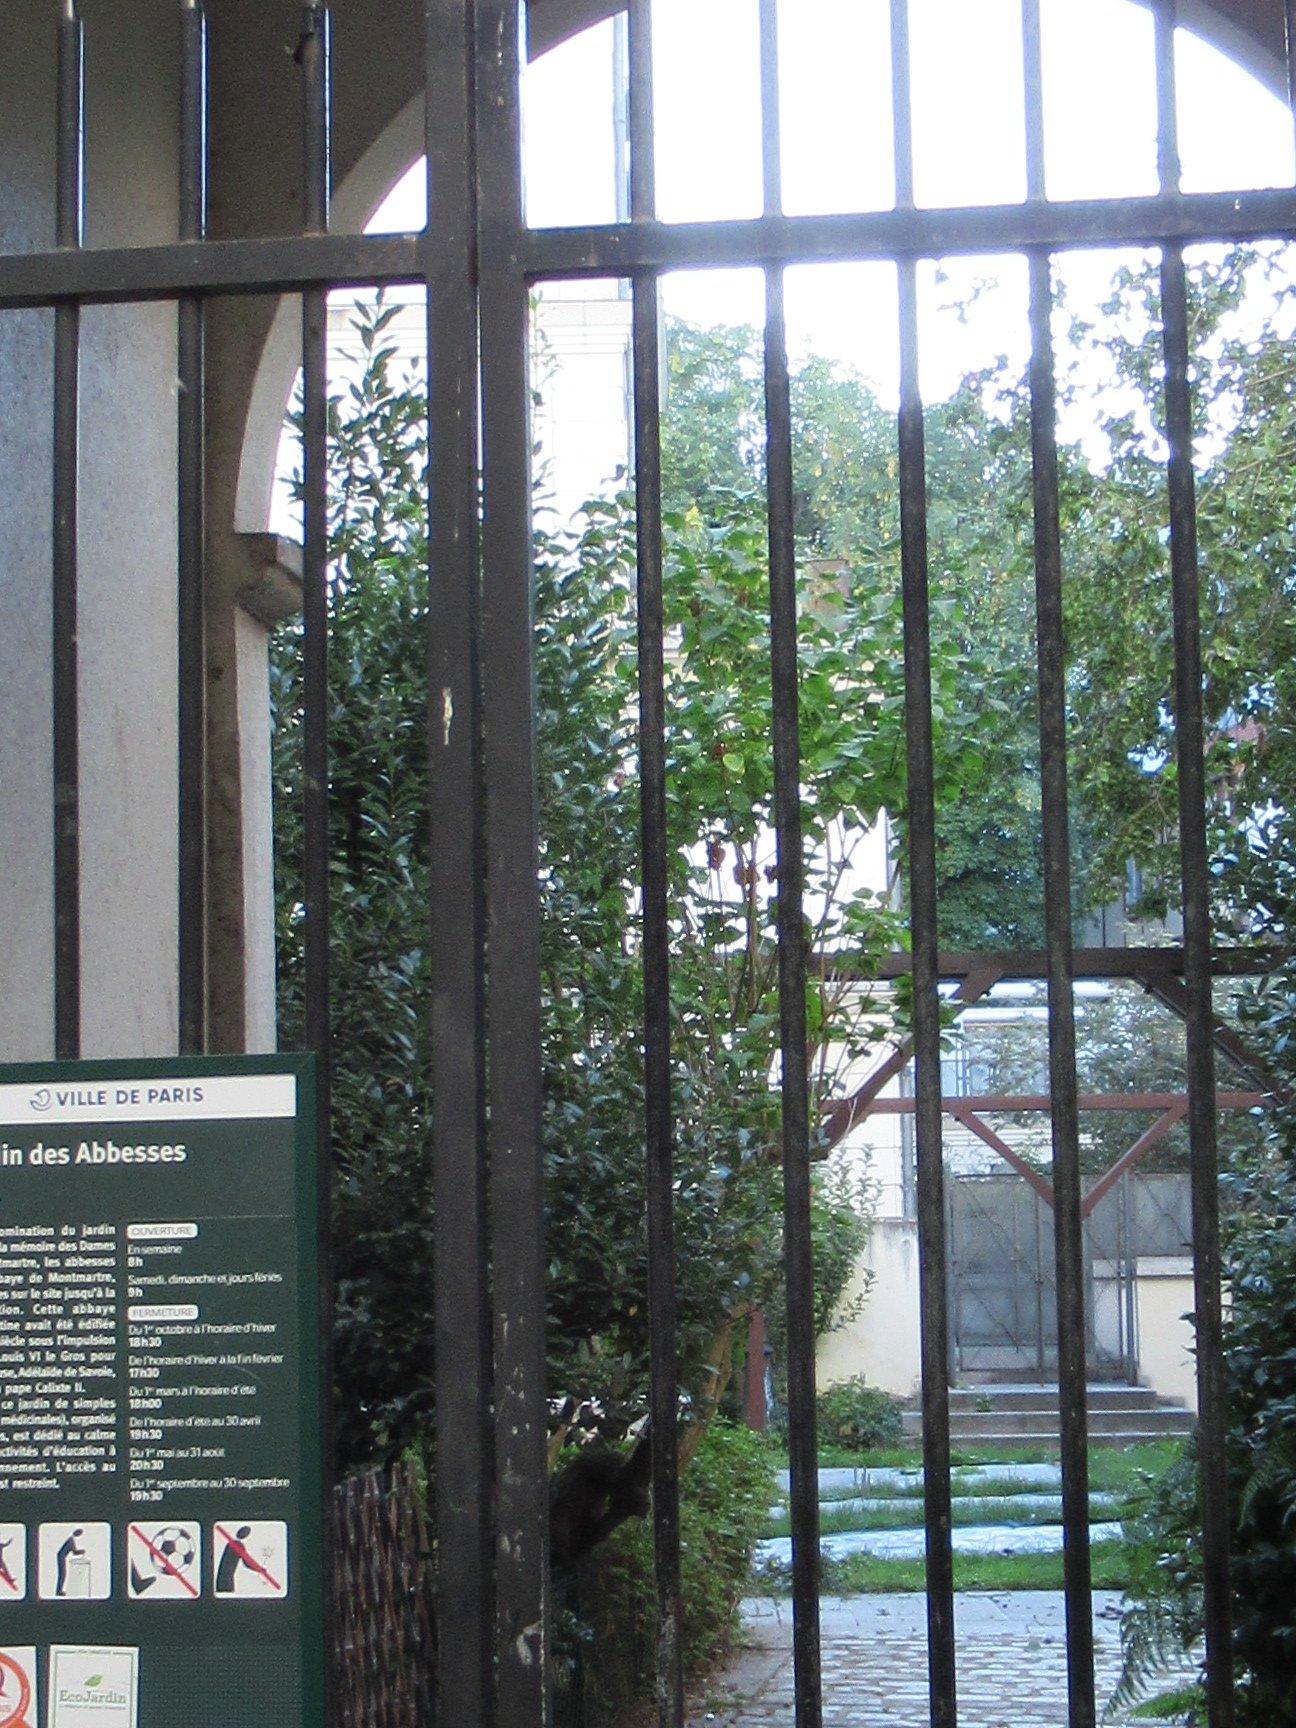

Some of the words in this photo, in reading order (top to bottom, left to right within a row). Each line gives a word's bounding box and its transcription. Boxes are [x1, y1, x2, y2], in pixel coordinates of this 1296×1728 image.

[57, 1091, 106, 1106] VILLE
[115, 1089, 141, 1105] DE
[148, 1086, 204, 1103] PARIS
[30, 1142, 70, 1165] des
[75, 1141, 187, 1164] Abbesses
[61, 1225, 76, 1236] du
[82, 1224, 116, 1237] jardin
[58, 1242, 77, 1251] des
[44, 1257, 60, 1267] les
[29, 1274, 43, 1283] de
[33, 1304, 64, 1314] Cette
[72, 1304, 116, 1317] abbaye
[61, 1352, 85, 1361] Gros
[90, 1352, 116, 1362] pour
[1, 1401, 14, 1409] ce
[54, 1398, 69, 1409] de
[102, 1463, 116, 1472] au
